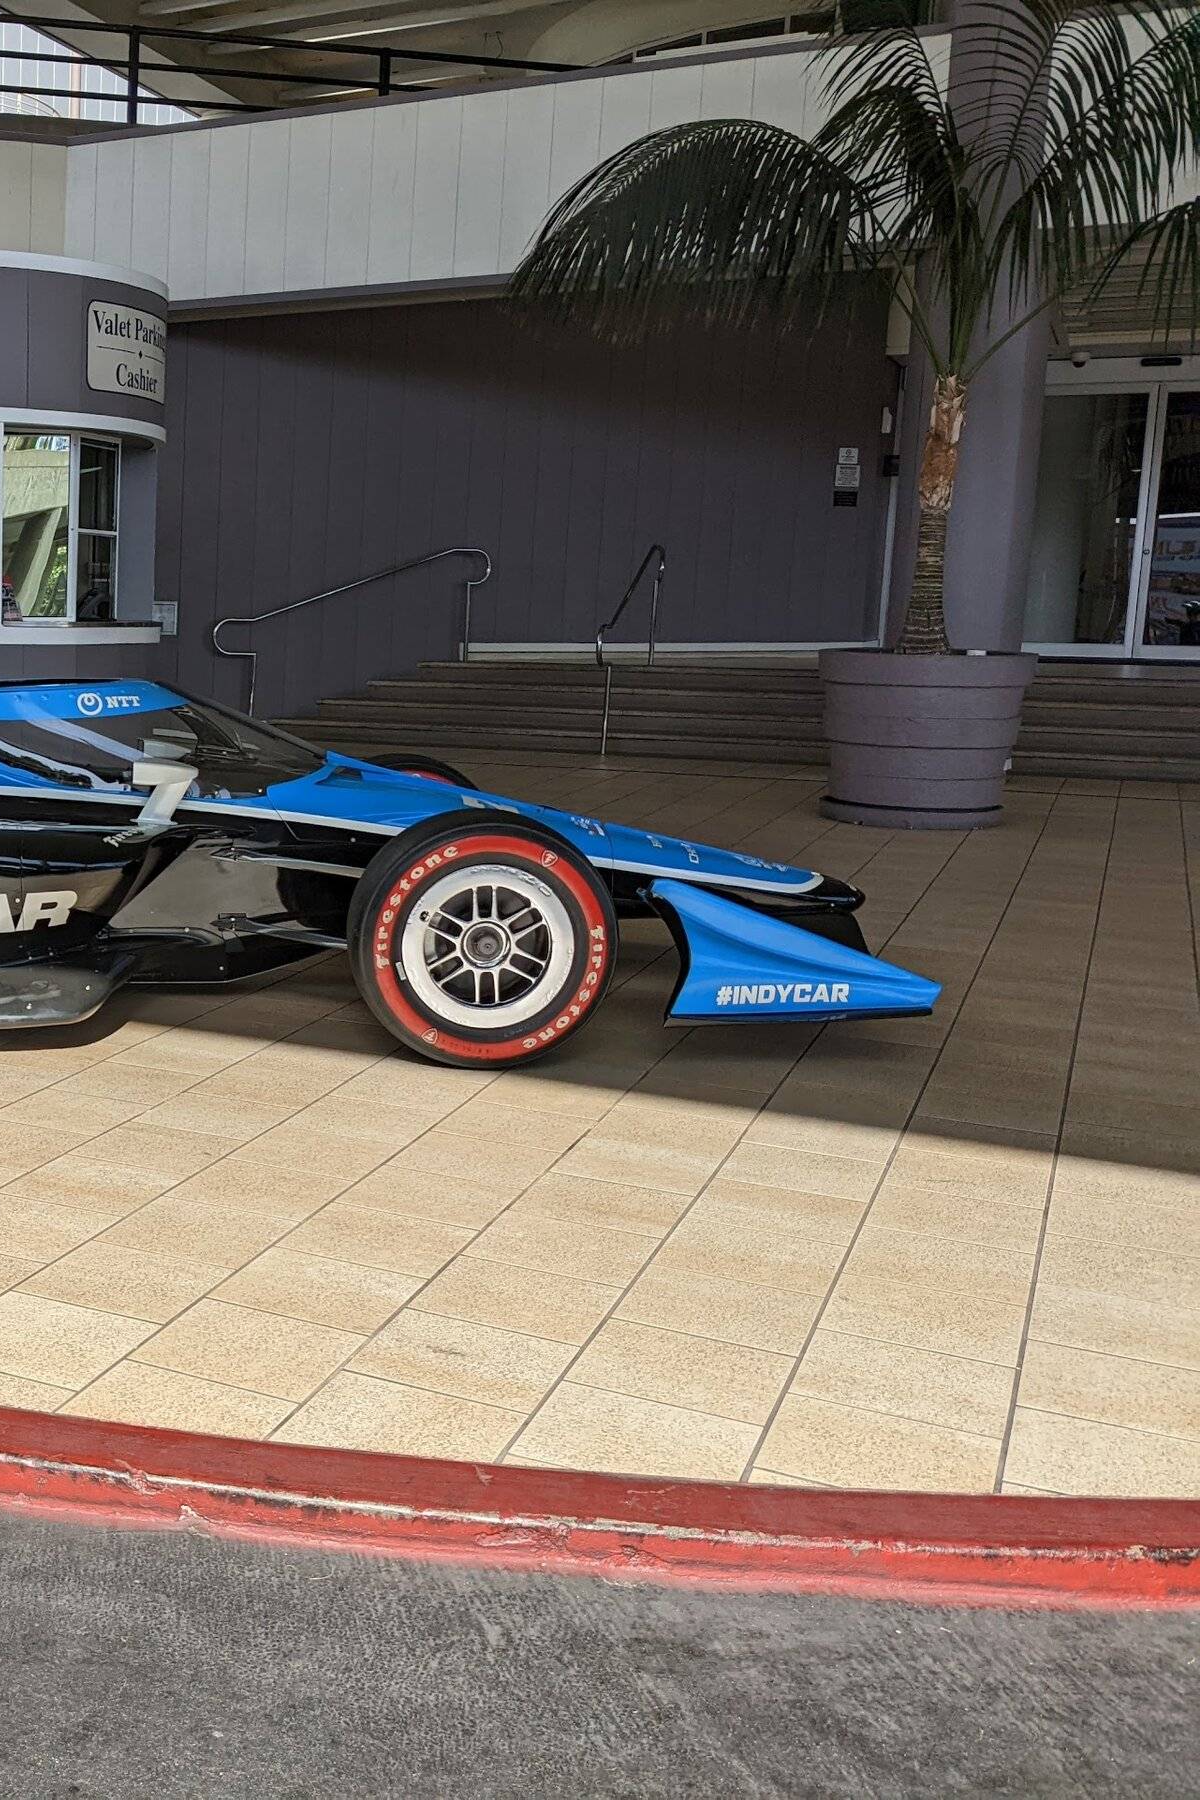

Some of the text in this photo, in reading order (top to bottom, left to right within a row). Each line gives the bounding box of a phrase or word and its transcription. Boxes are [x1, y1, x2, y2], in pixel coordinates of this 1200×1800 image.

[92, 310, 131, 338] Valet
[116, 363, 158, 393] Cashier
[104, 695, 141, 709] NTT
[376, 846, 458, 969] Firestone
[522, 925, 604, 1048] Firestone
[716, 983, 850, 1006] #INDYCAR
